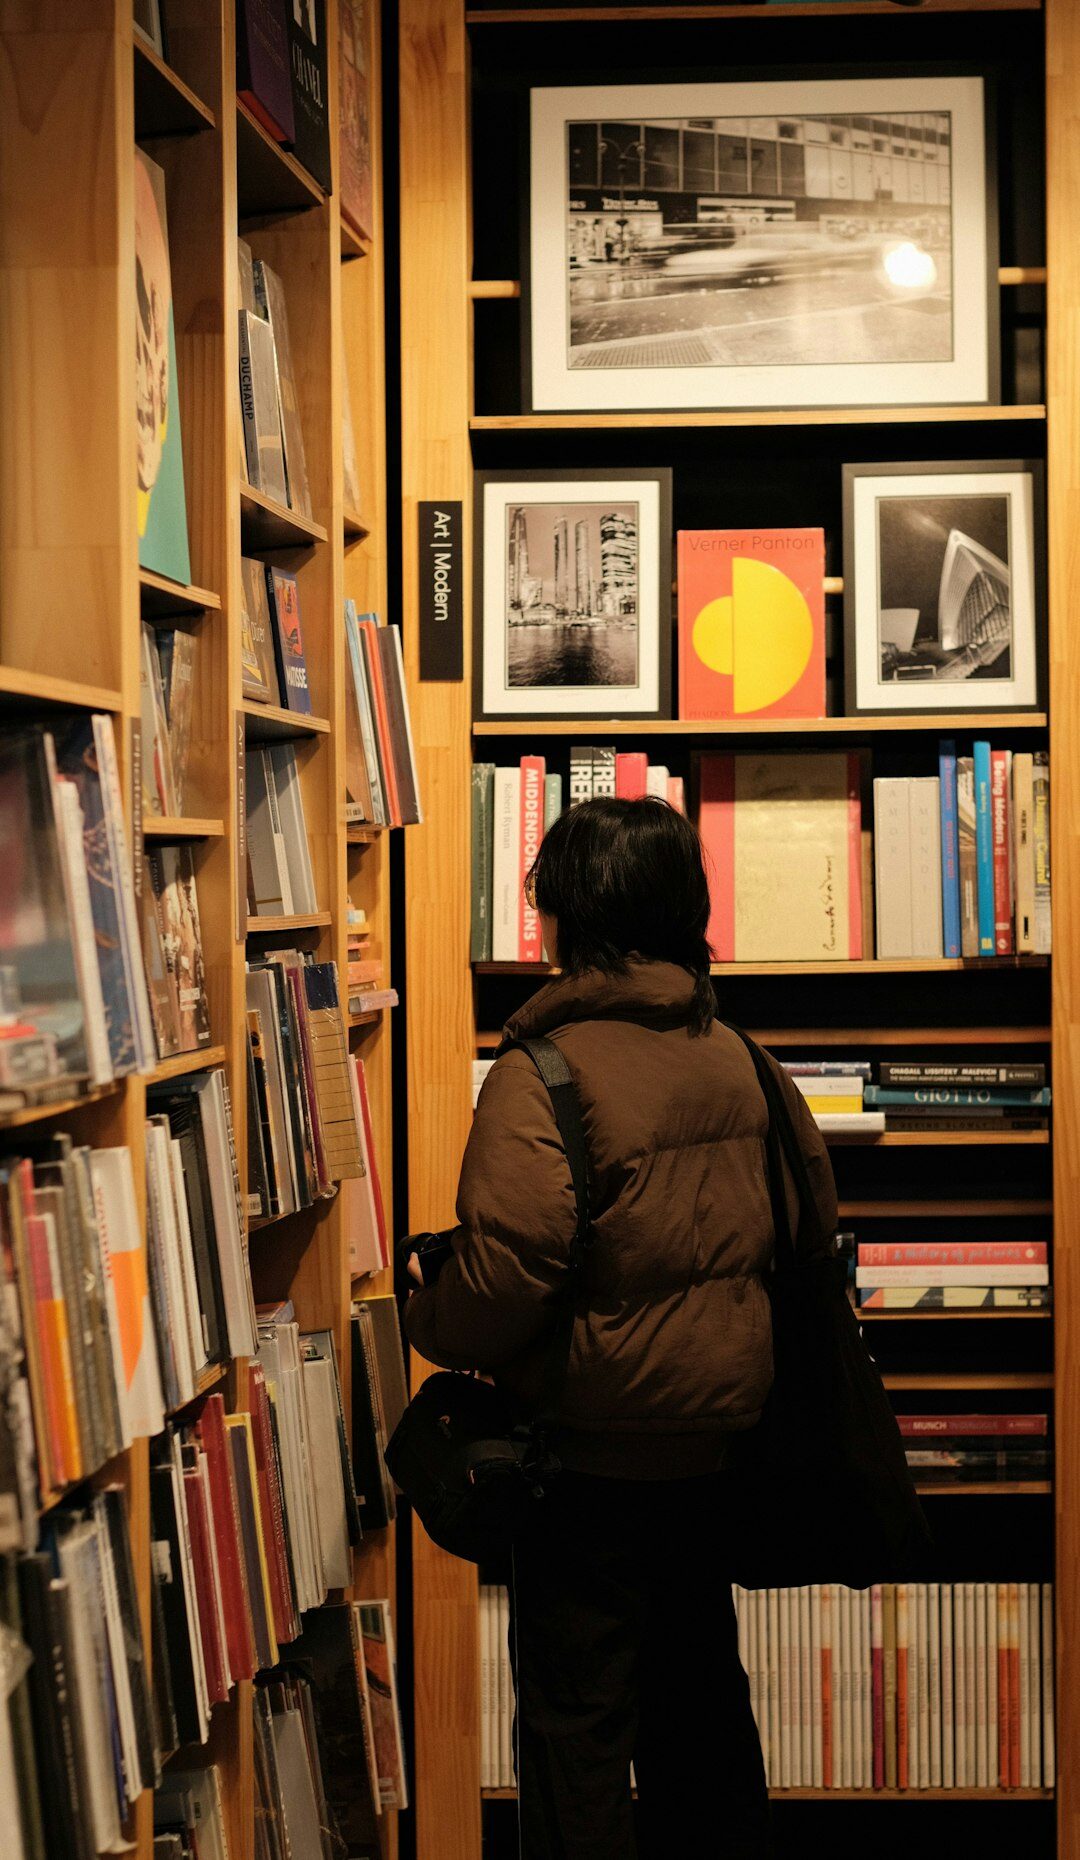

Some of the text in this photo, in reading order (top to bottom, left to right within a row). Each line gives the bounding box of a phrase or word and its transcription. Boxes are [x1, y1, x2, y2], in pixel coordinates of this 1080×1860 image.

[241, 357, 254, 420] DUCHAMP
[434, 510, 452, 538] Art
[689, 535, 815, 551] Verner Panton
[434, 553, 452, 621] Modern
[285, 666, 308, 690] MATISSE
[237, 724, 245, 757] Art
[992, 760, 1006, 796] Being
[133, 733, 143, 898] Photography
[237, 776, 246, 856] Classic
[502, 783, 513, 849] Robert Ryman
[993, 797, 1007, 845] Modern
[889, 1067, 997, 1076] CHAGALL LISSITZKY MALEVICH
[914, 1088, 991, 1104] GIOTTO
[912, 1421, 948, 1430] MUNCH
